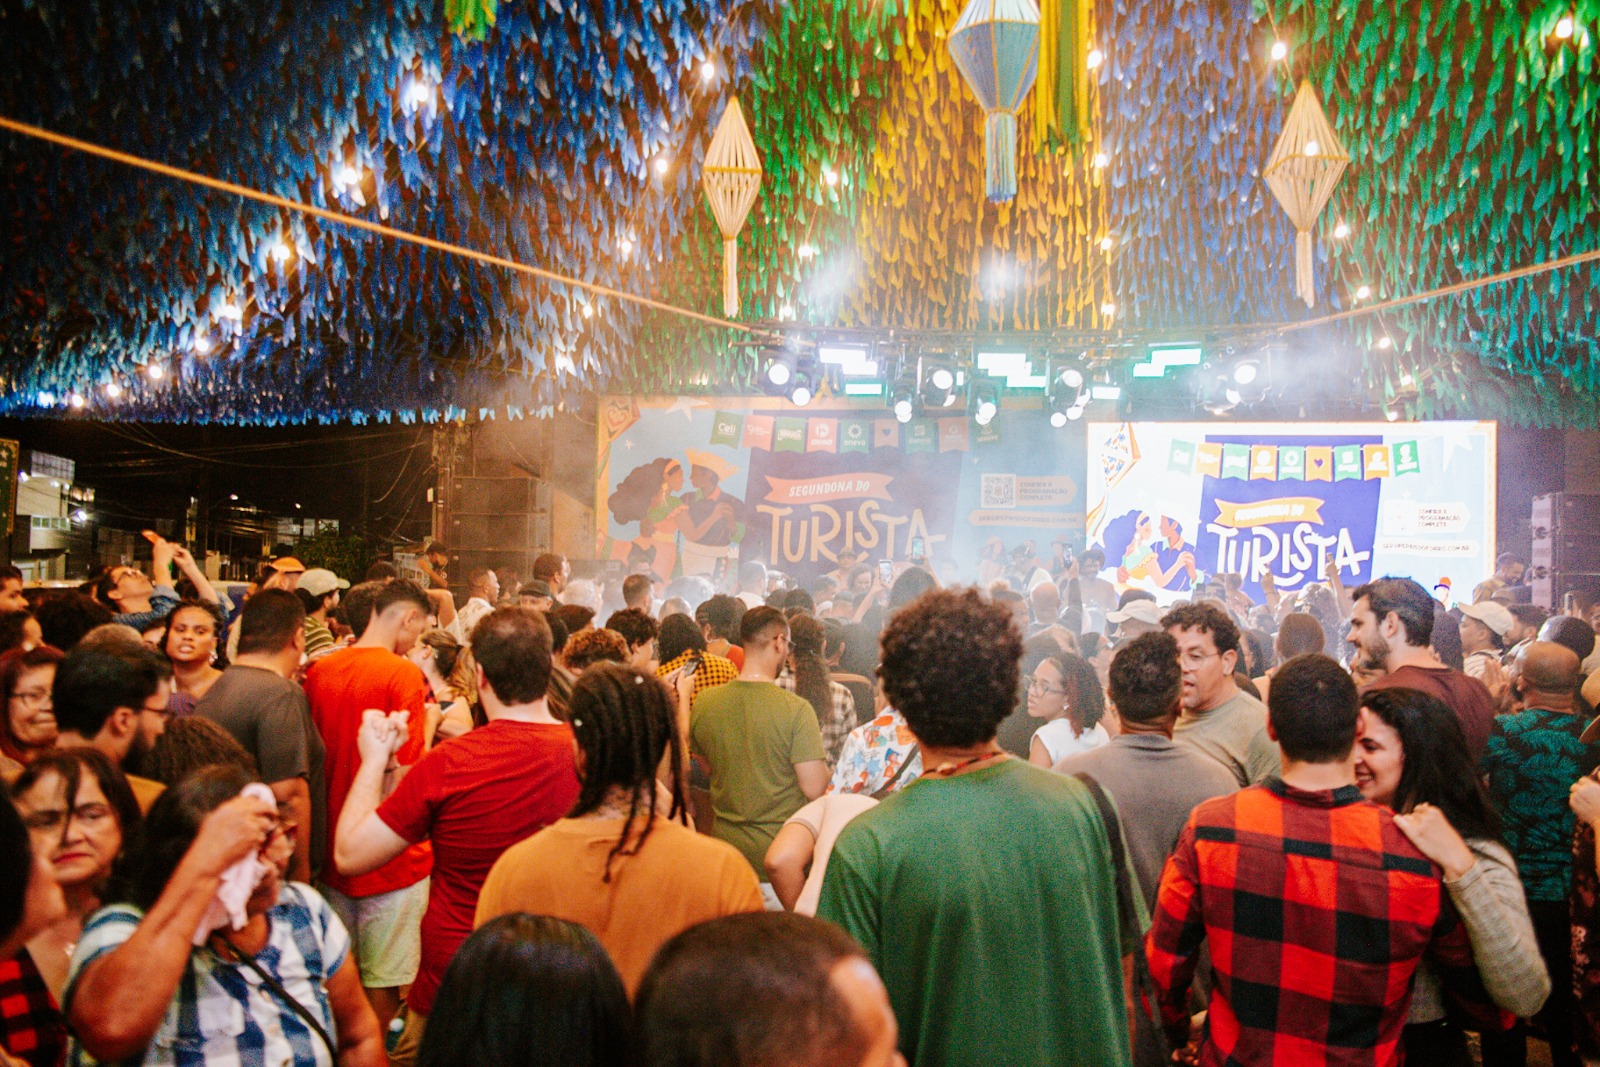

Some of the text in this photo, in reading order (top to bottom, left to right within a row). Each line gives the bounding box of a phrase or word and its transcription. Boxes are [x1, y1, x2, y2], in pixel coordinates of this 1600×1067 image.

[718, 423, 736, 433] Celi
[789, 480, 870, 497] SEGUNDONA DO
[756, 500, 946, 566] TURISTA
[1206, 523, 1370, 586] TURISTA
